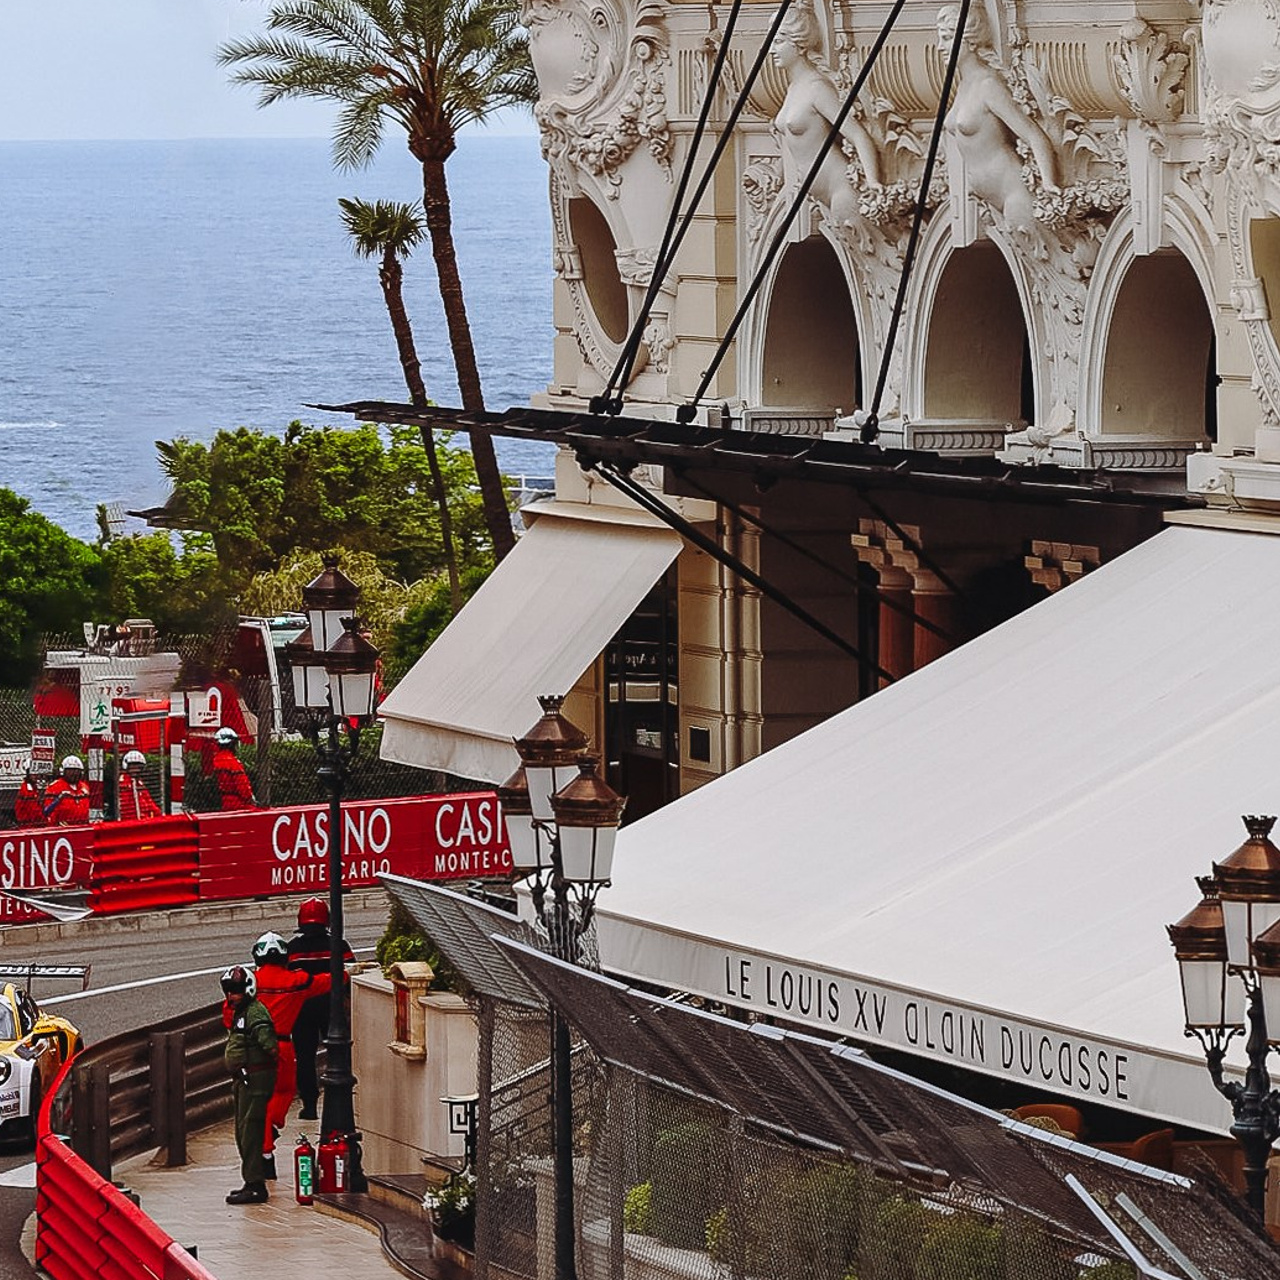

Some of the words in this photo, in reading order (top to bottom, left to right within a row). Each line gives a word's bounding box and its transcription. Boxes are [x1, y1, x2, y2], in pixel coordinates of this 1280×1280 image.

[272, 807, 391, 861] CASNO
[435, 800, 502, 848] CASI
[272, 864, 326, 886] MONTE
[435, 851, 490, 873] MONTE
[726, 956, 751, 1000] LE
[767, 966, 840, 1022] LOUIS
[854, 988, 887, 1034] XV
[905, 1003, 985, 1063] ALAIN
[1001, 1026, 1128, 1100] DUCASSE
